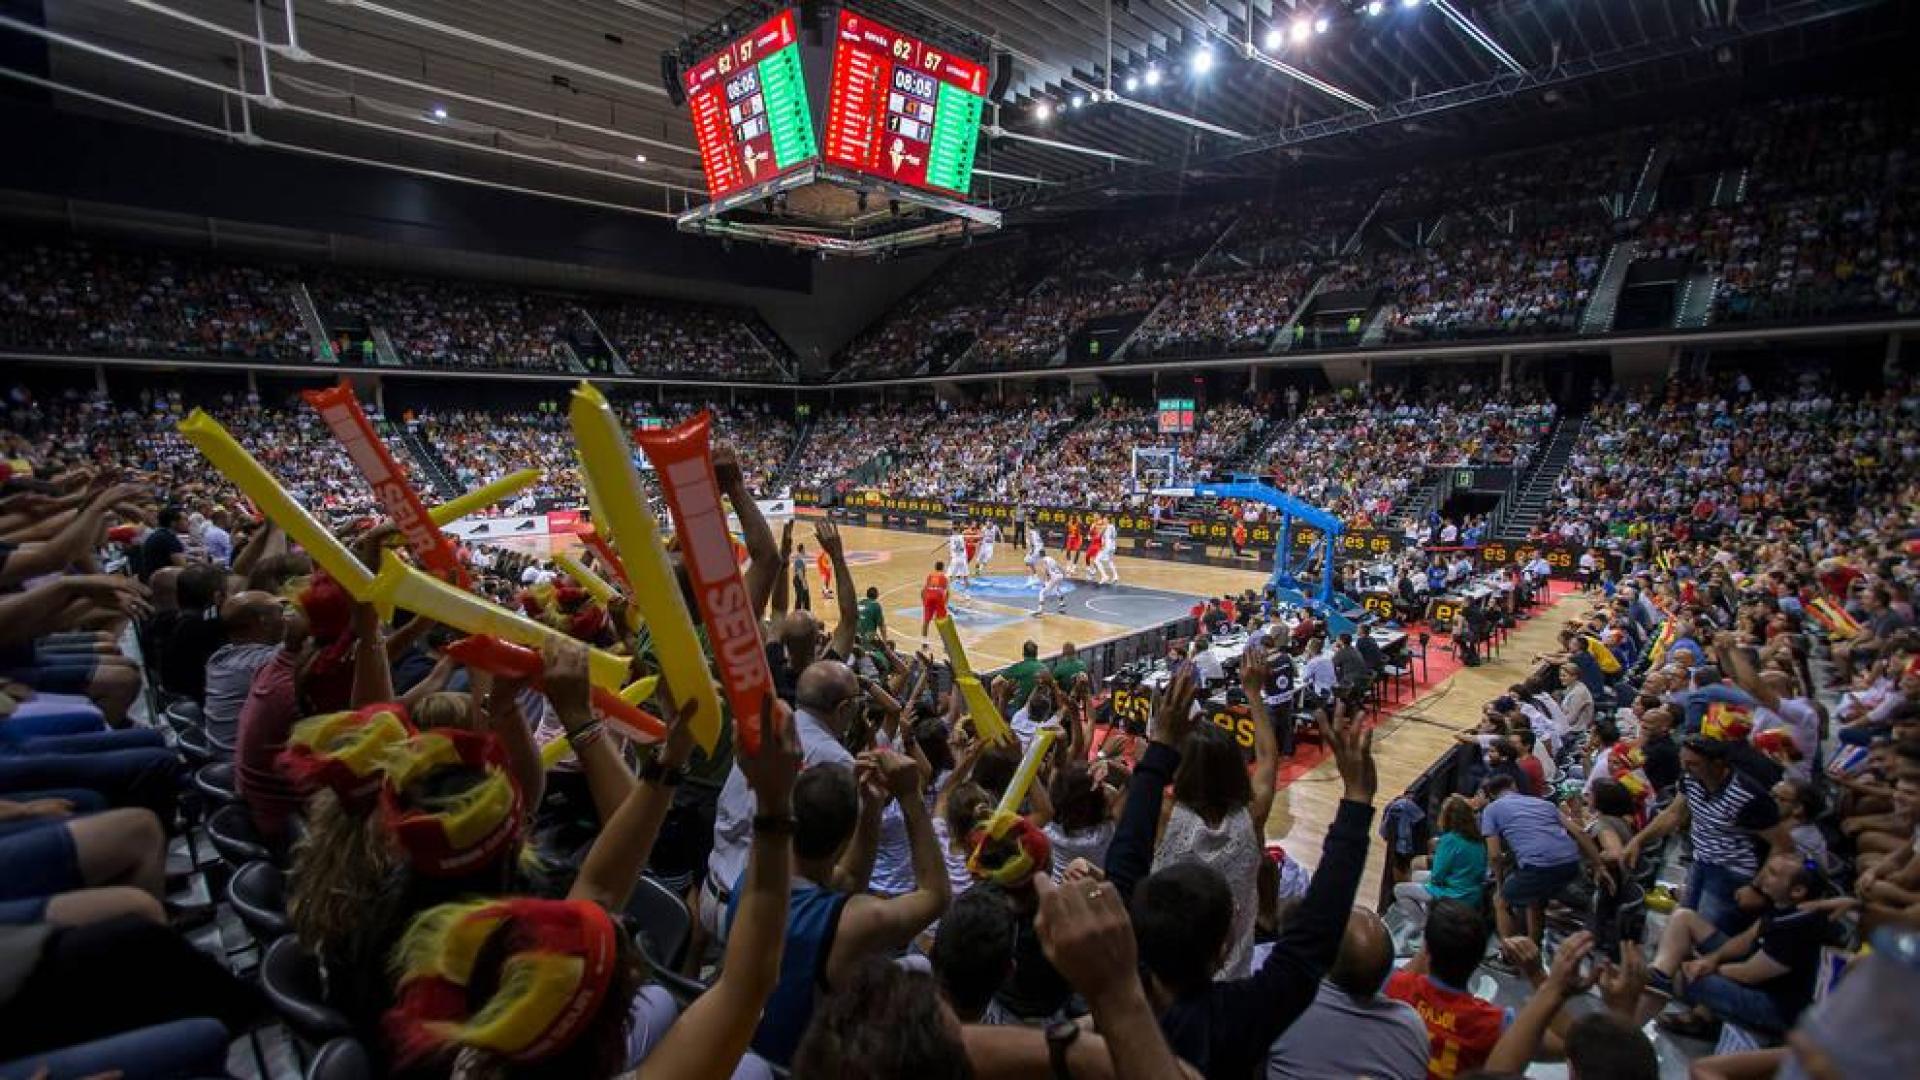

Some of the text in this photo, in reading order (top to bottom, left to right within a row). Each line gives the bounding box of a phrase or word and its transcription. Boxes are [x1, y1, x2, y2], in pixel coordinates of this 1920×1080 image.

[894, 39, 912, 60] 62
[925, 52, 942, 70] 57
[895, 70, 932, 97] 08:05
[374, 483, 437, 556] SEUR
[1252, 528, 1269, 540] es
[1297, 533, 1314, 544] es
[1345, 536, 1365, 549] es
[1371, 538, 1391, 551] es
[1483, 547, 1506, 561] es
[1547, 552, 1571, 567] es
[1364, 598, 1392, 618] es
[708, 583, 765, 691] SEUR
[1214, 712, 1256, 747] es
